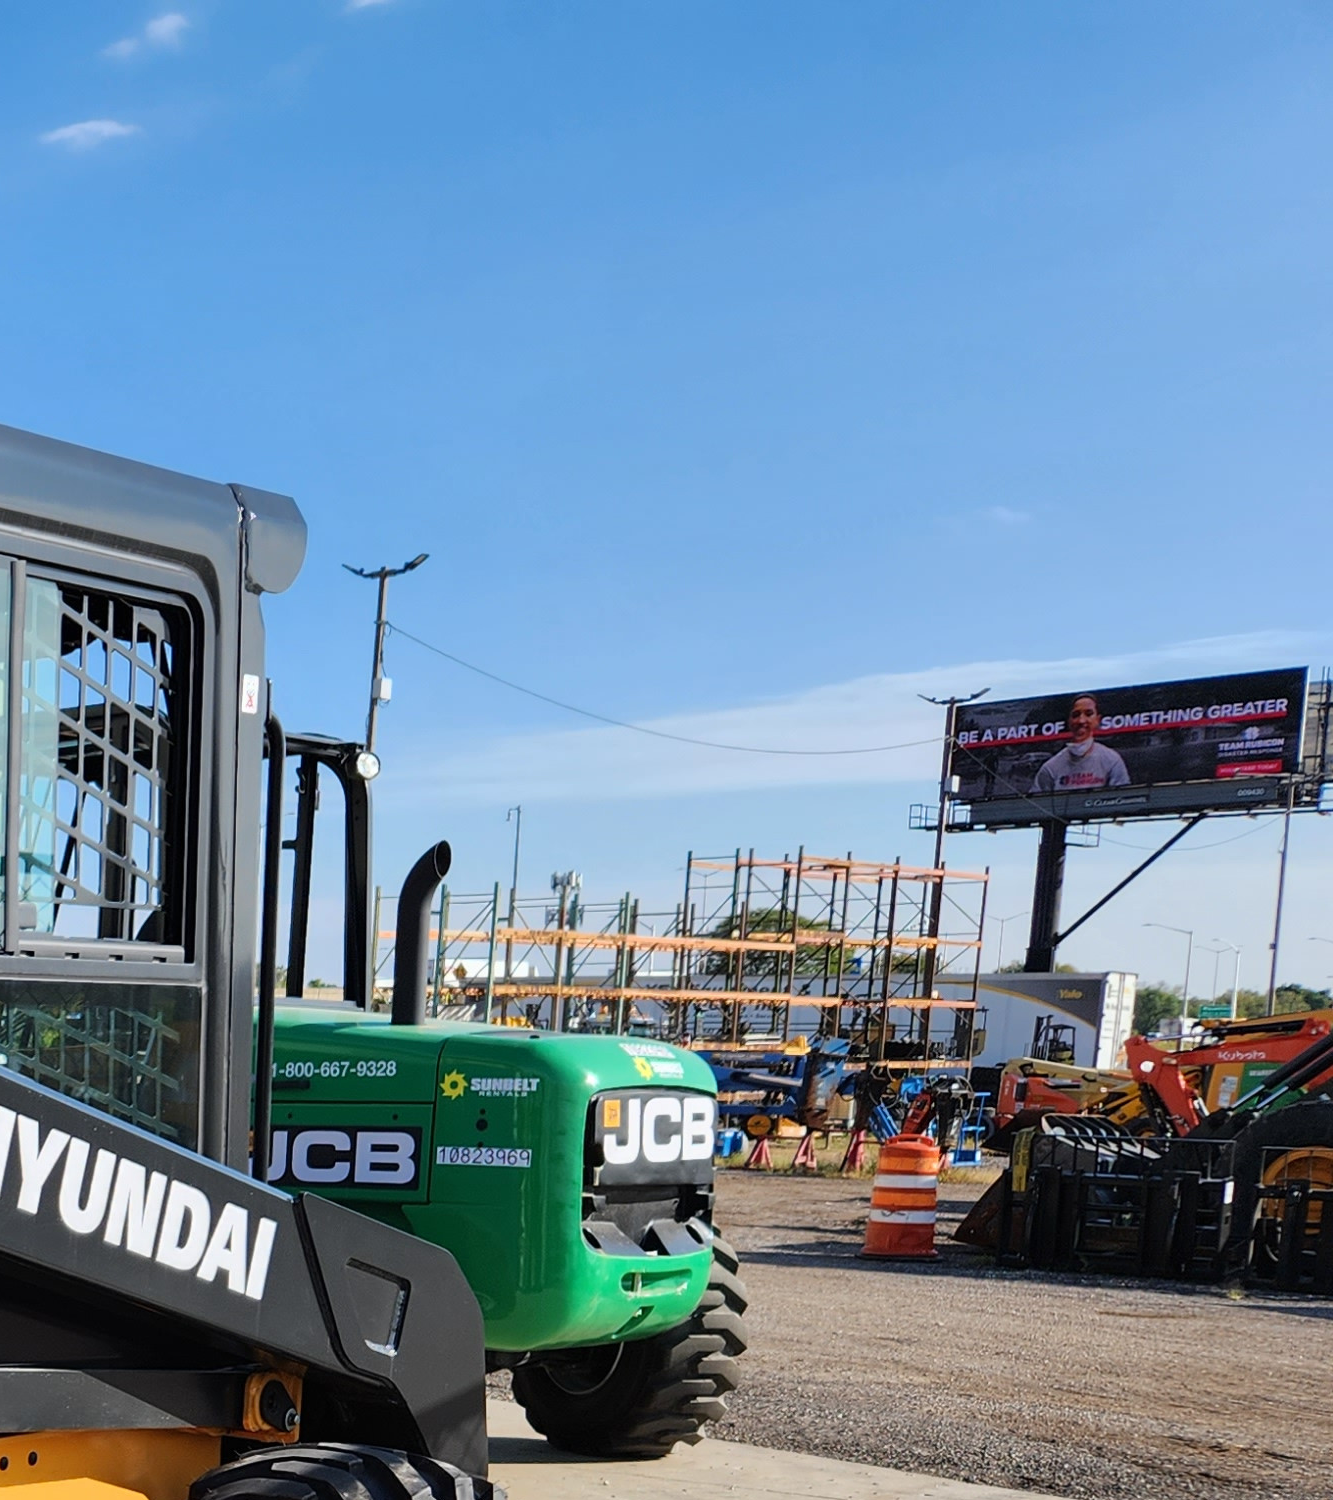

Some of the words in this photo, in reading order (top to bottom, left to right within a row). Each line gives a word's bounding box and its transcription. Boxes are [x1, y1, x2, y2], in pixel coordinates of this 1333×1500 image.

[958, 730, 979, 744] BE
[982, 729, 993, 742] A
[997, 724, 1038, 740] PART
[1041, 721, 1065, 735] OF
[1100, 706, 1203, 730] SOMETHING
[1207, 698, 1288, 719] GREATER
[1218, 741, 1244, 751] TEAM
[1218, 1049, 1266, 1060] Kubota
[271, 1061, 397, 1079] 1-800-667-9328
[470, 1078, 540, 1091] SUNBELT
[603, 1097, 715, 1164] JCB
[250, 1130, 415, 1184] JCB
[438, 1147, 531, 1166] 10823969
